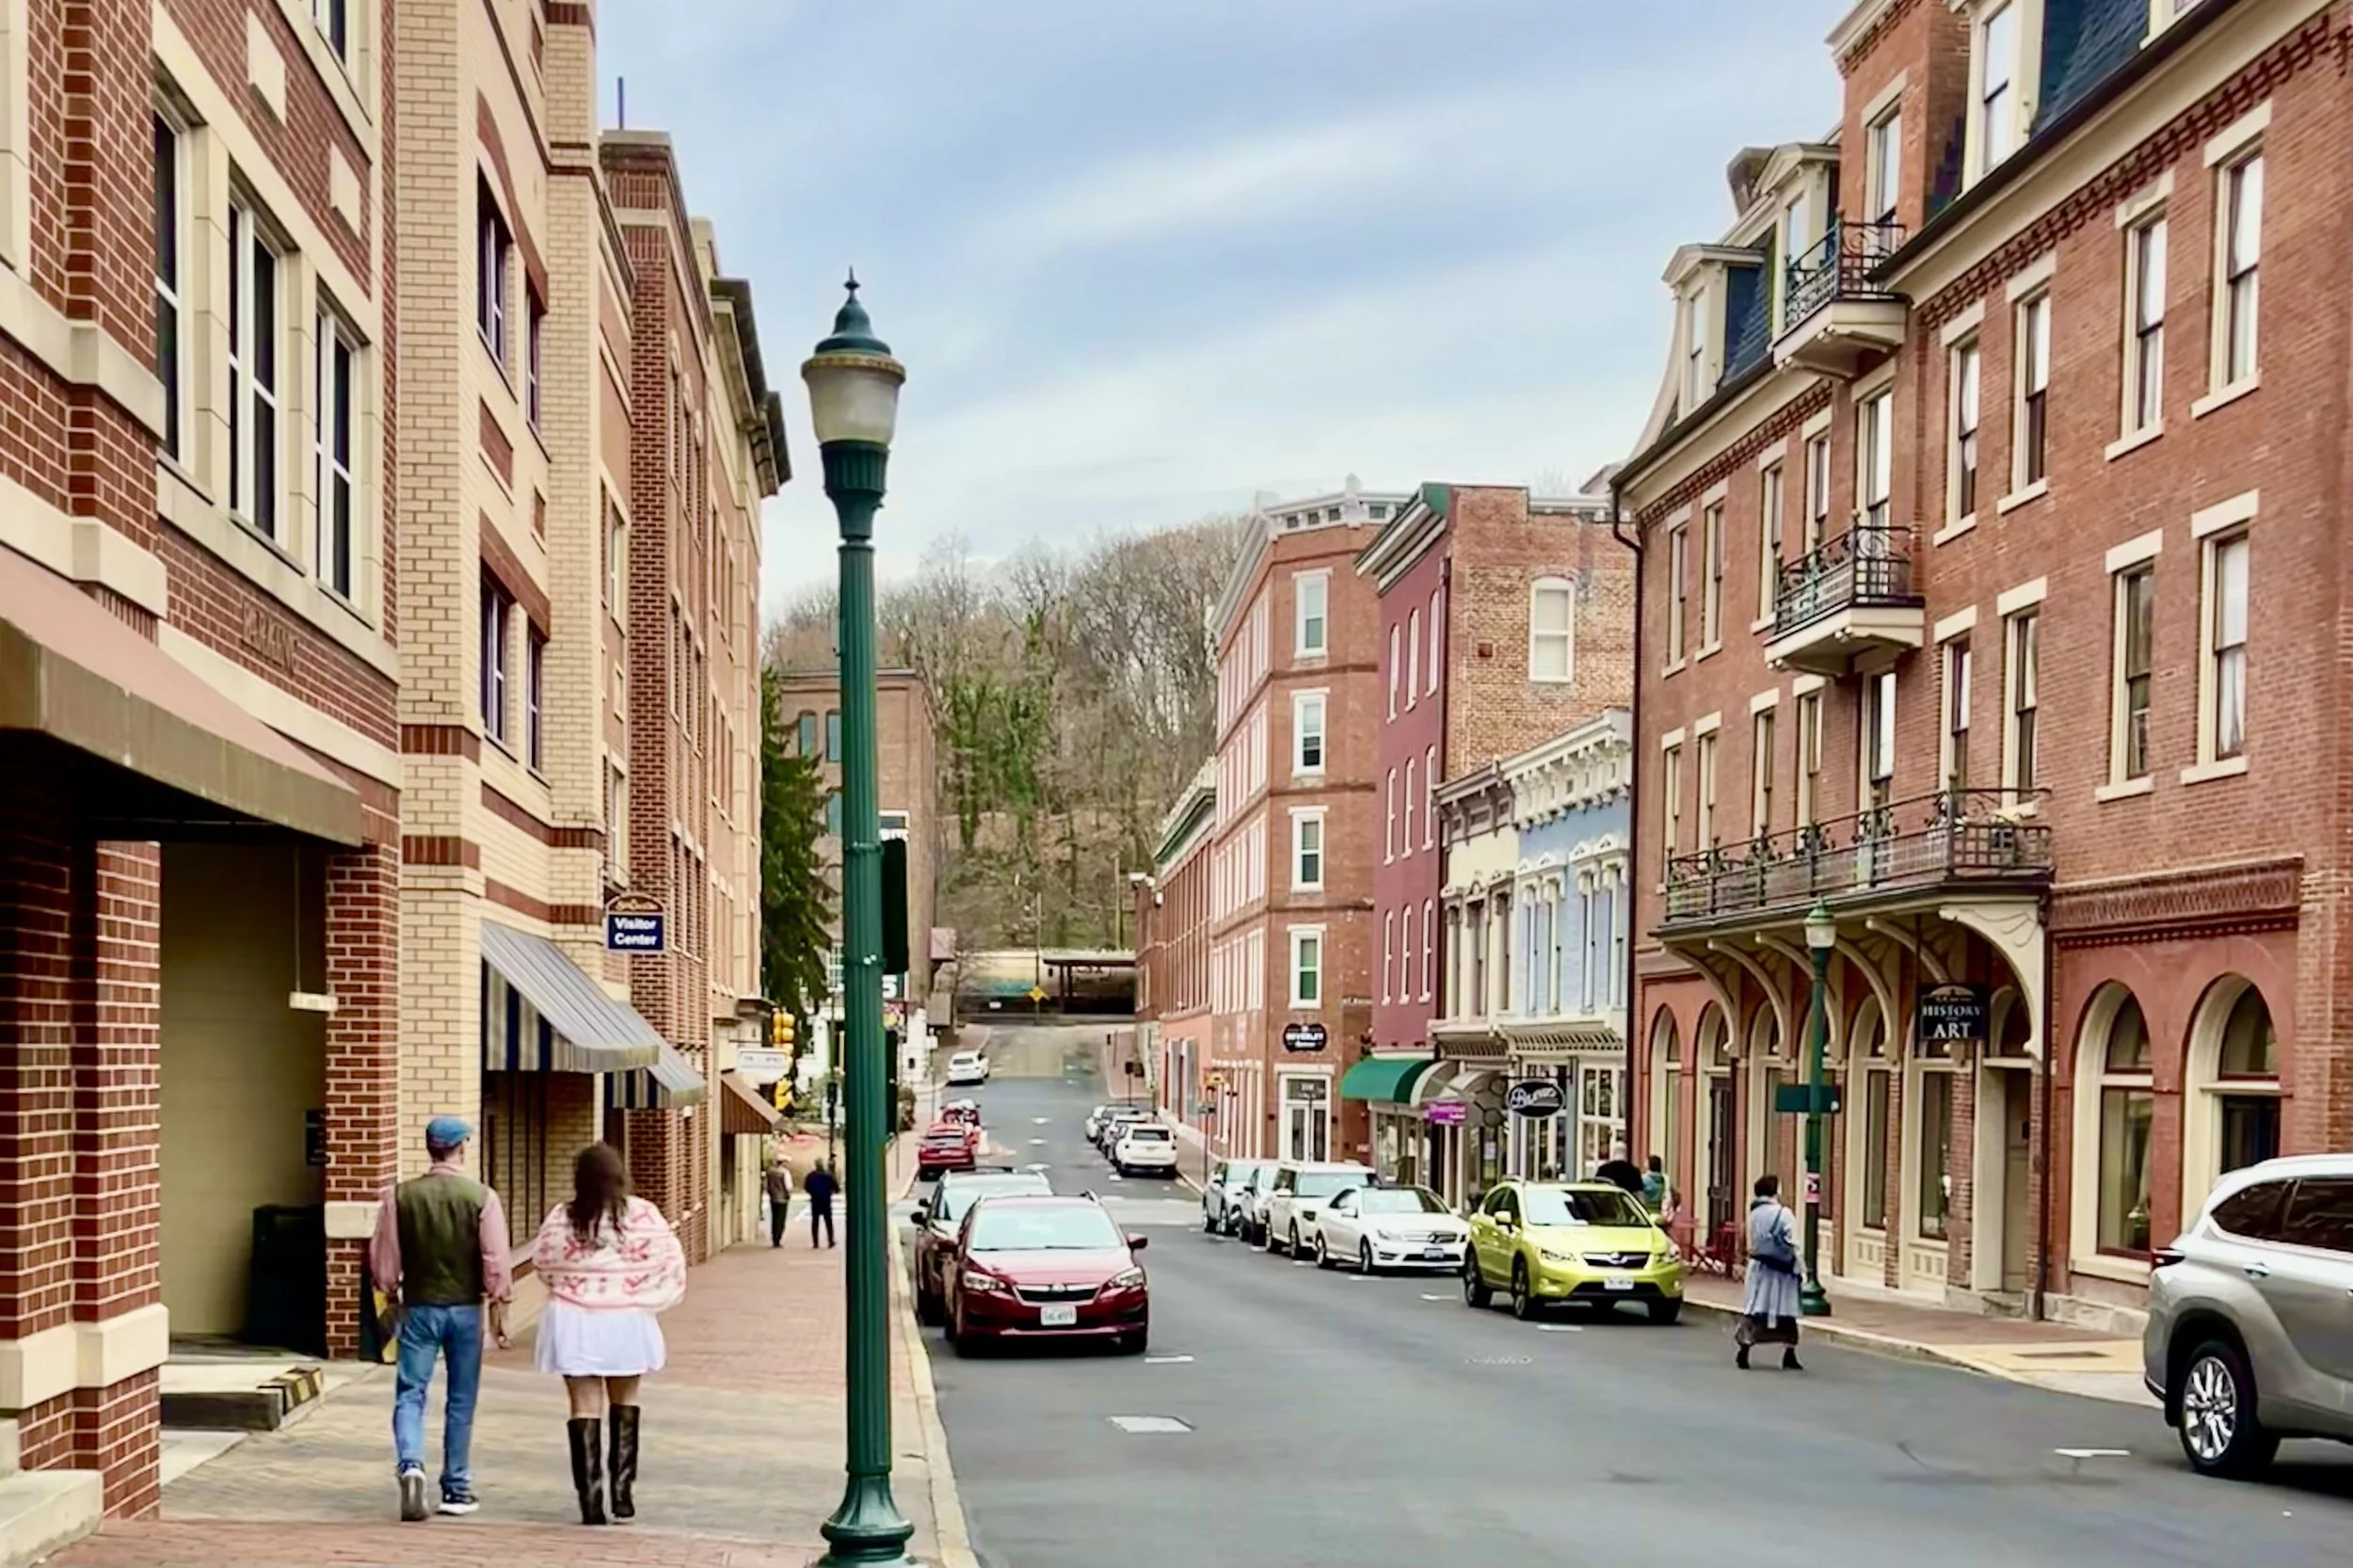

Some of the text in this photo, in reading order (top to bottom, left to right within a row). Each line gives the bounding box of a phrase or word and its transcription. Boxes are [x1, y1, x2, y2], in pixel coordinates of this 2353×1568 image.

[615, 918, 657, 930] Visitor
[615, 933, 657, 945] Center
[1922, 1004, 1982, 1016] HISTORY
[1932, 1022, 1972, 1039] ART
